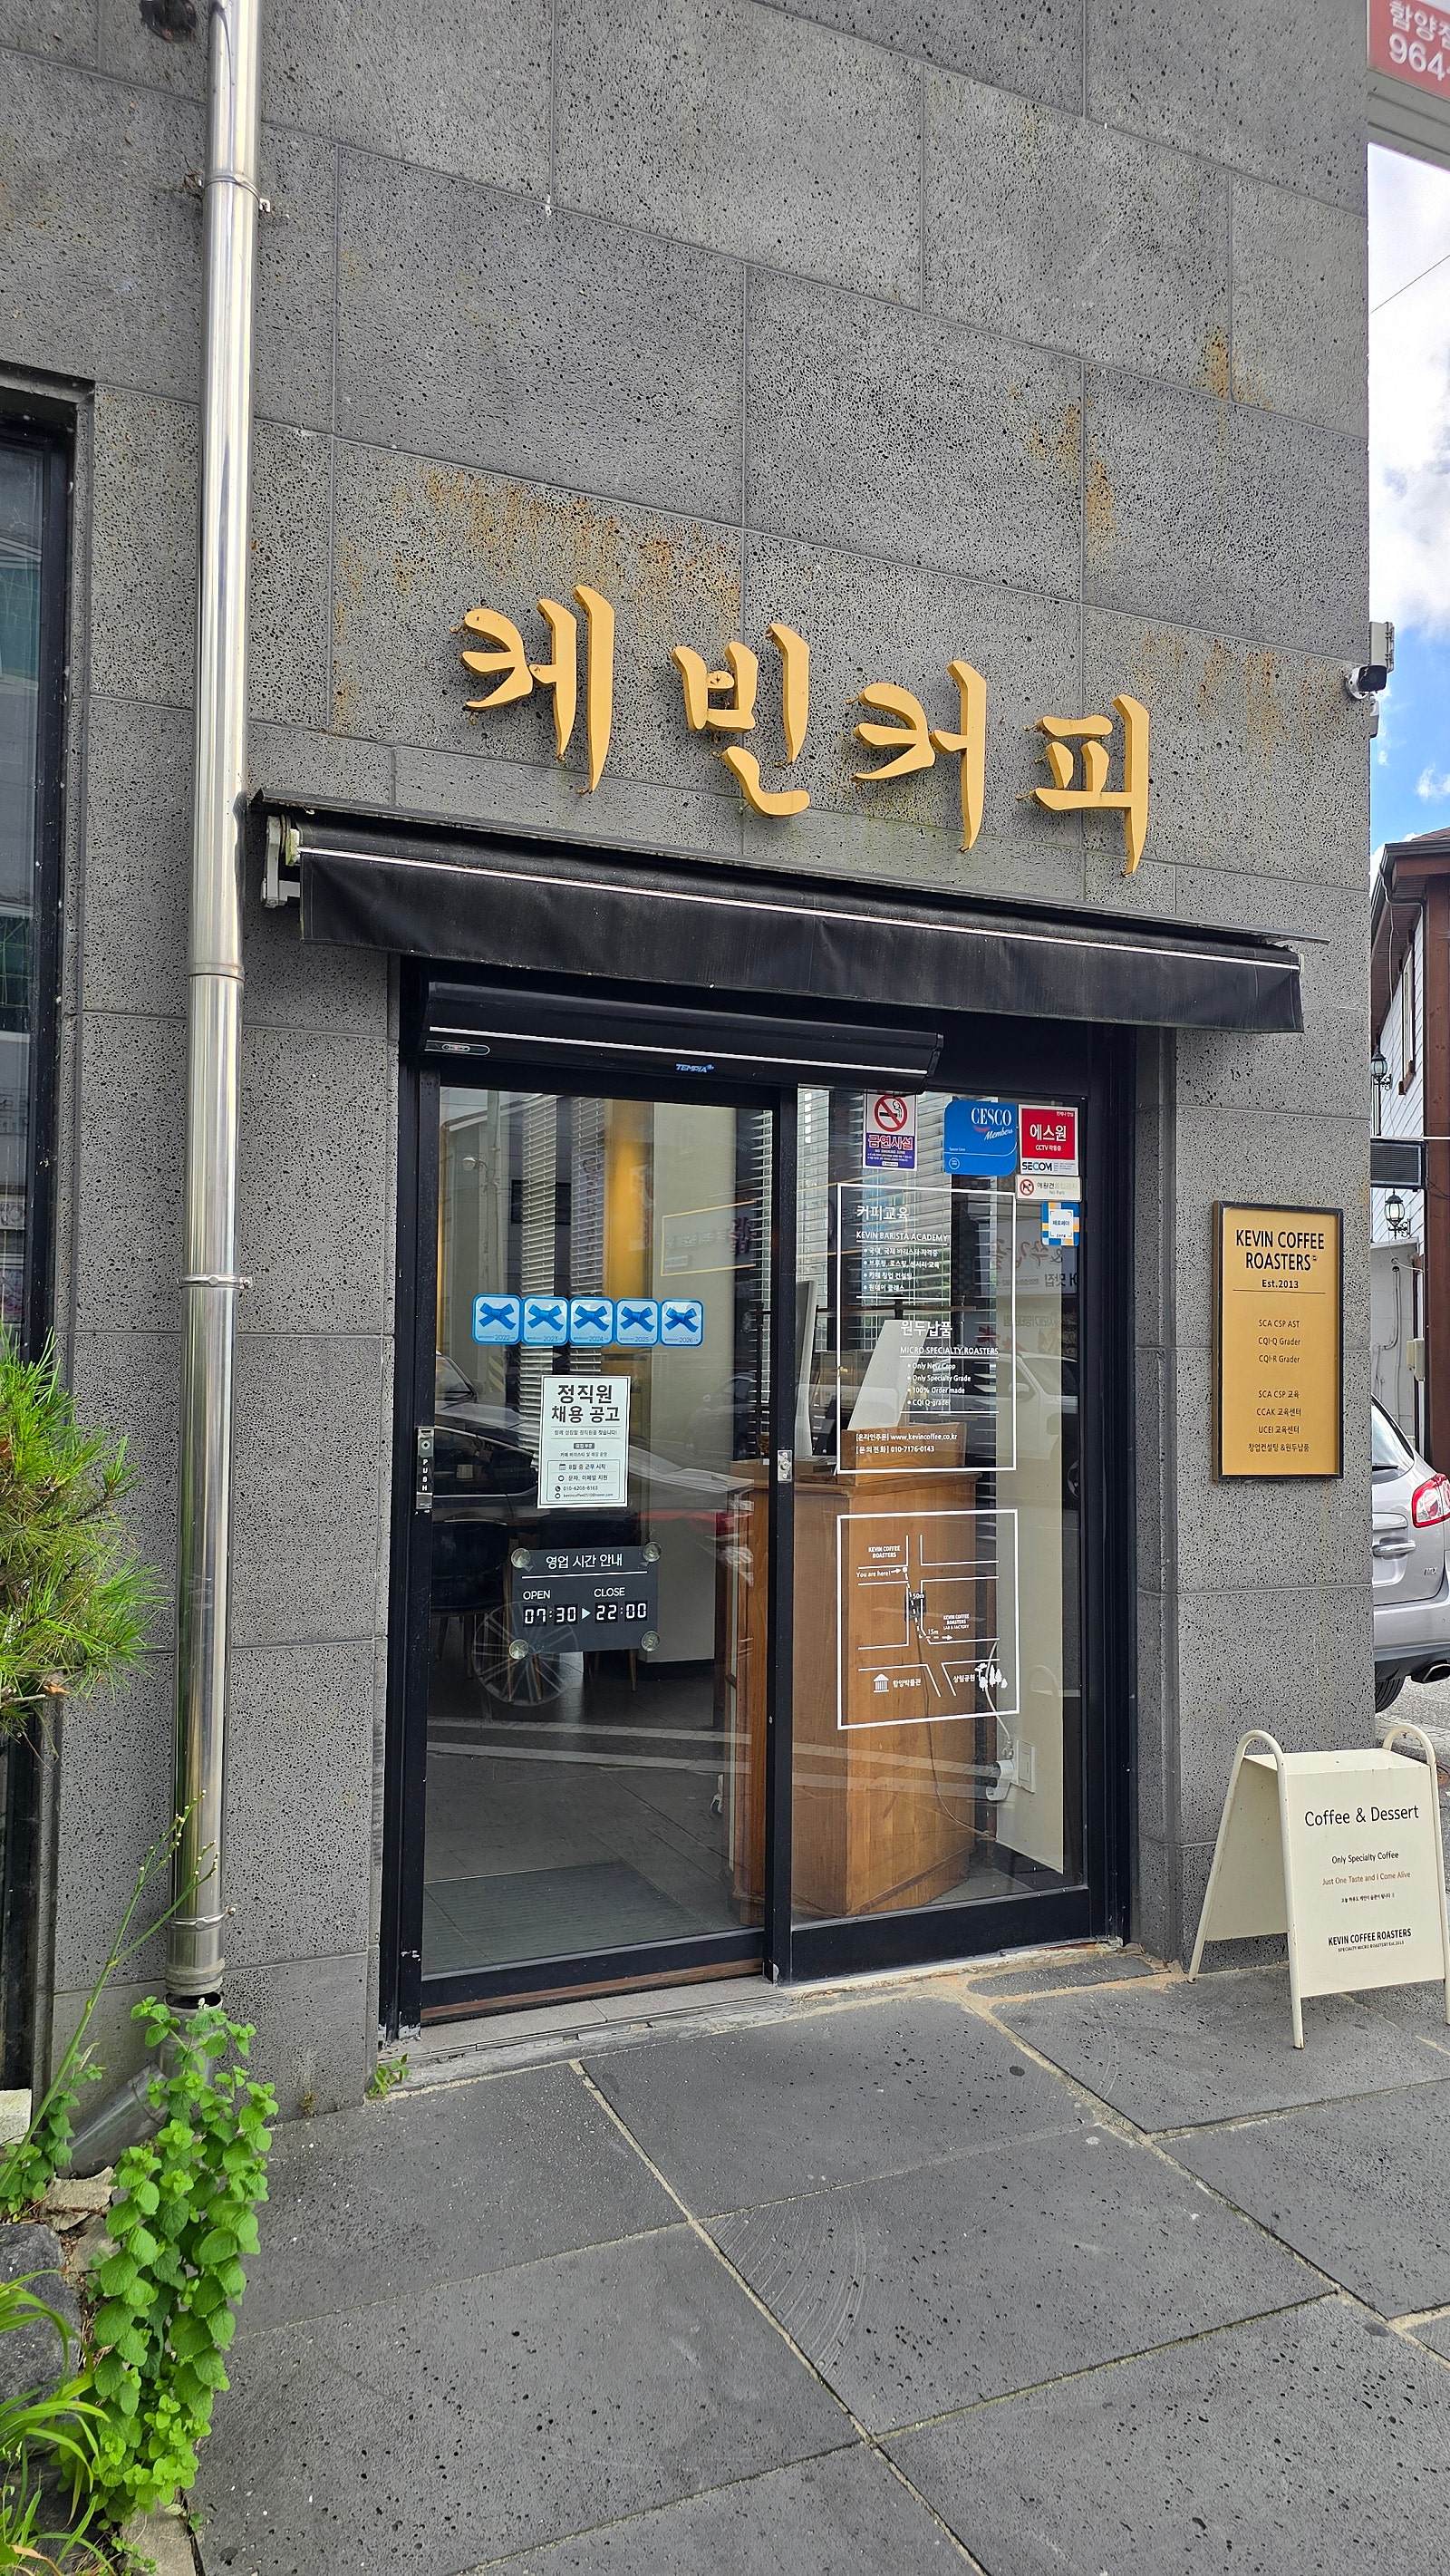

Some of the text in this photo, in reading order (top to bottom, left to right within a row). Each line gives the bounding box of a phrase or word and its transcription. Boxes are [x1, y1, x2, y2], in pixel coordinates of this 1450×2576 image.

[460, 585, 1150, 876] 케빈커피
[971, 1107, 1012, 1127] CESCO
[983, 1128, 1013, 1141] Members
[1030, 1124, 1067, 1142] 에스원
[867, 1134, 914, 1151] 금연시설
[1021, 1161, 1053, 1172] SECOM
[856, 1205, 910, 1222] 커피교육
[856, 1231, 948, 1243] KEVIN BARISTA ACADEMY
[1236, 1229, 1325, 1250] KEVIN COFFEE
[1245, 1252, 1311, 1271] ROASTERS
[1262, 1279, 1299, 1289] Est.2013
[900, 1320, 953, 1337] 원두납품
[1258, 1319, 1300, 1329] SCA CSP AST
[1279, 1337, 1301, 1346] Grader
[900, 1346, 999, 1356] MICRO SPECIALTY ROASTERS
[912, 1361, 925, 1370] Only
[1279, 1355, 1300, 1363] Grader
[912, 1374, 972, 1383] Only Specialty Grade
[557, 1384, 614, 1404] 정직원
[913, 1386, 930, 1394] 100%
[931, 1386, 948, 1394] Order
[1258, 1390, 1300, 1399] SCA CSP 교육
[912, 1399, 924, 1407] CQI
[551, 1406, 621, 1423] 채용 공고
[1256, 1408, 1302, 1417] CCAK 교육센터
[1258, 1426, 1300, 1435] UCEI 교육센터
[890, 1433, 958, 1442] www.kevincoffee.co.kr
[890, 1445, 935, 1453] 010-7176-0143
[546, 1553, 624, 1570] 영업 시간 안내
[523, 1587, 626, 1601] OPEN CLOSE
[524, 1603, 647, 1624] 07:30 22:00
[1304, 1805, 1419, 1827] Coffee & Dessert
[1331, 1850, 1399, 1864] Only Specialty Coffee
[1322, 1878, 1334, 1886] Just
[1335, 1876, 1348, 1884] One
[1348, 1875, 1364, 1884] Taste
[1365, 1874, 1376, 1882] and
[1379, 1873, 1397, 1881] Come
[1397, 1871, 1411, 1879] Alive
[1328, 1928, 1412, 1946] KEVIN COFFEE ROASTERS
